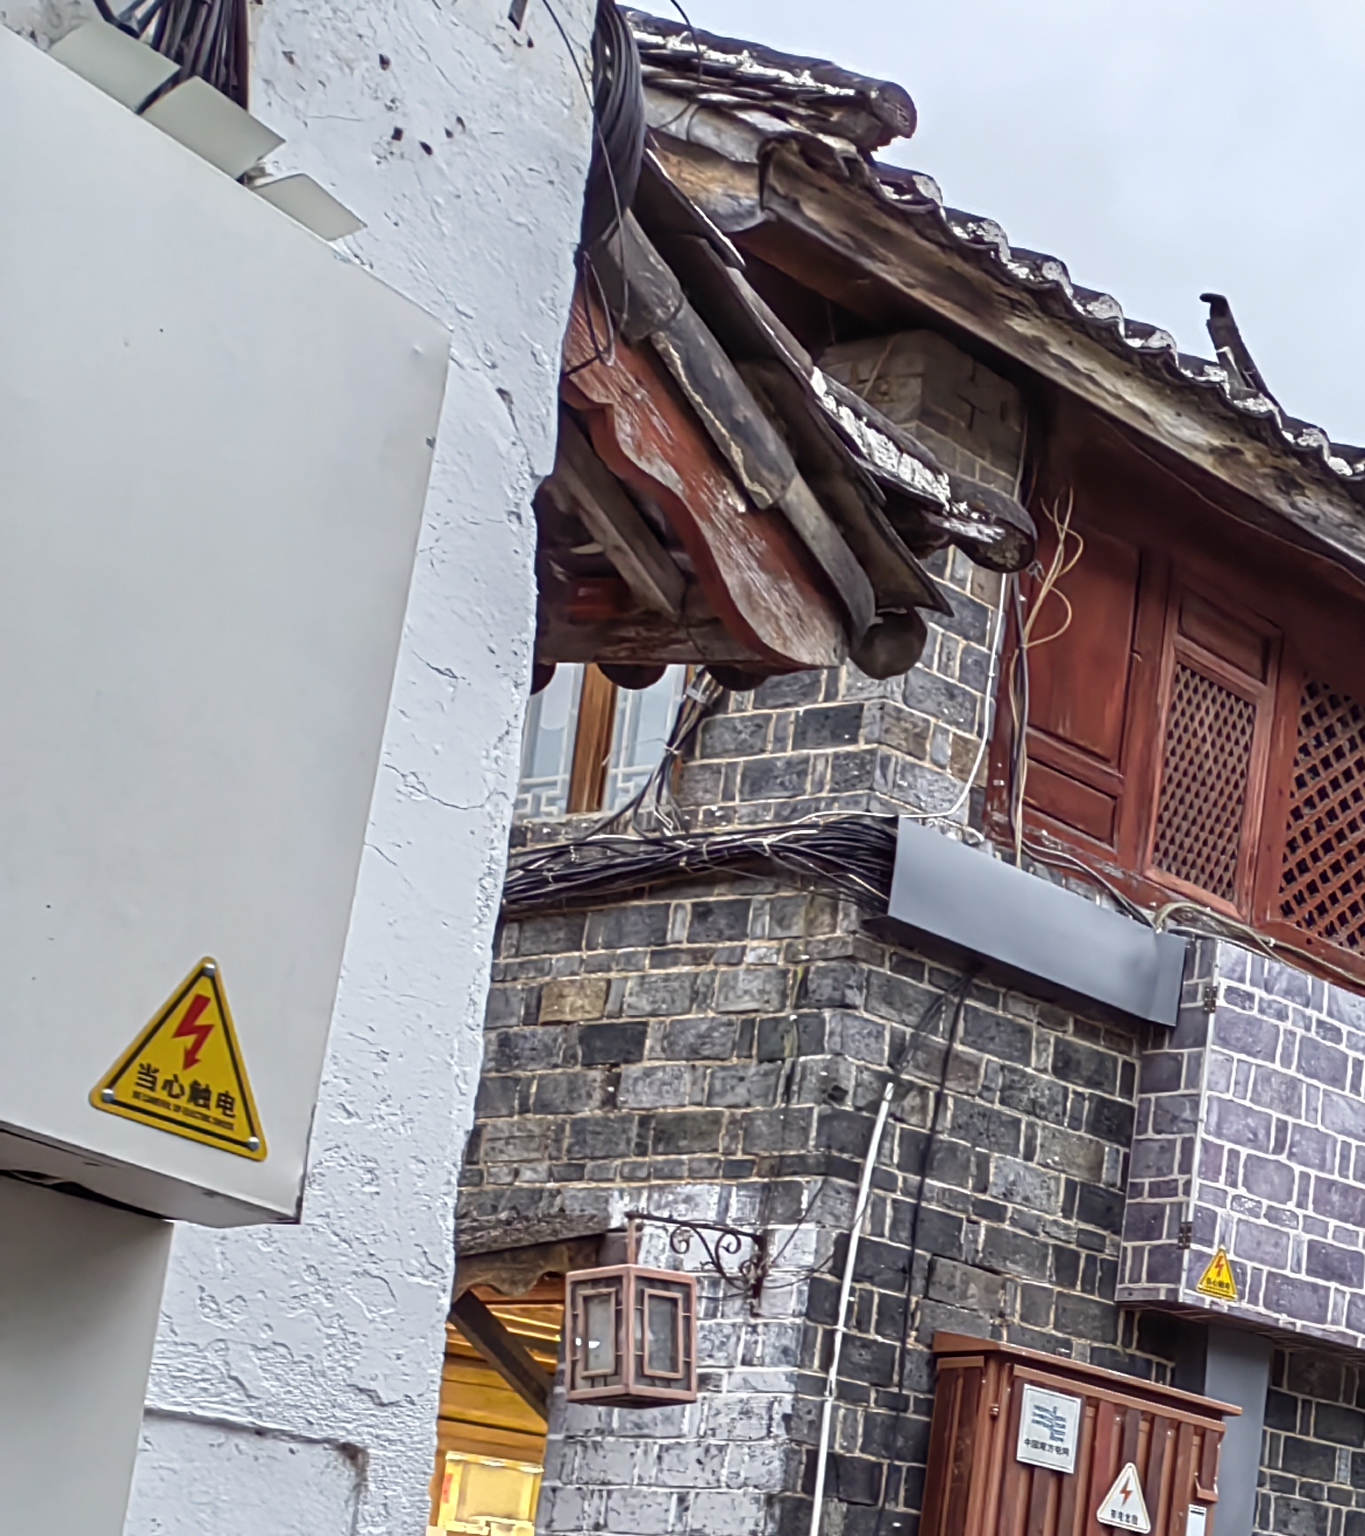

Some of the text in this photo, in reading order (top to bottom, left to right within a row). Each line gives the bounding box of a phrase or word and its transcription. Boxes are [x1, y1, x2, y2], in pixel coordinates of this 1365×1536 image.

[134, 1062, 237, 1119] 当心触电
[1023, 1438, 1070, 1457] 中国南方电网
